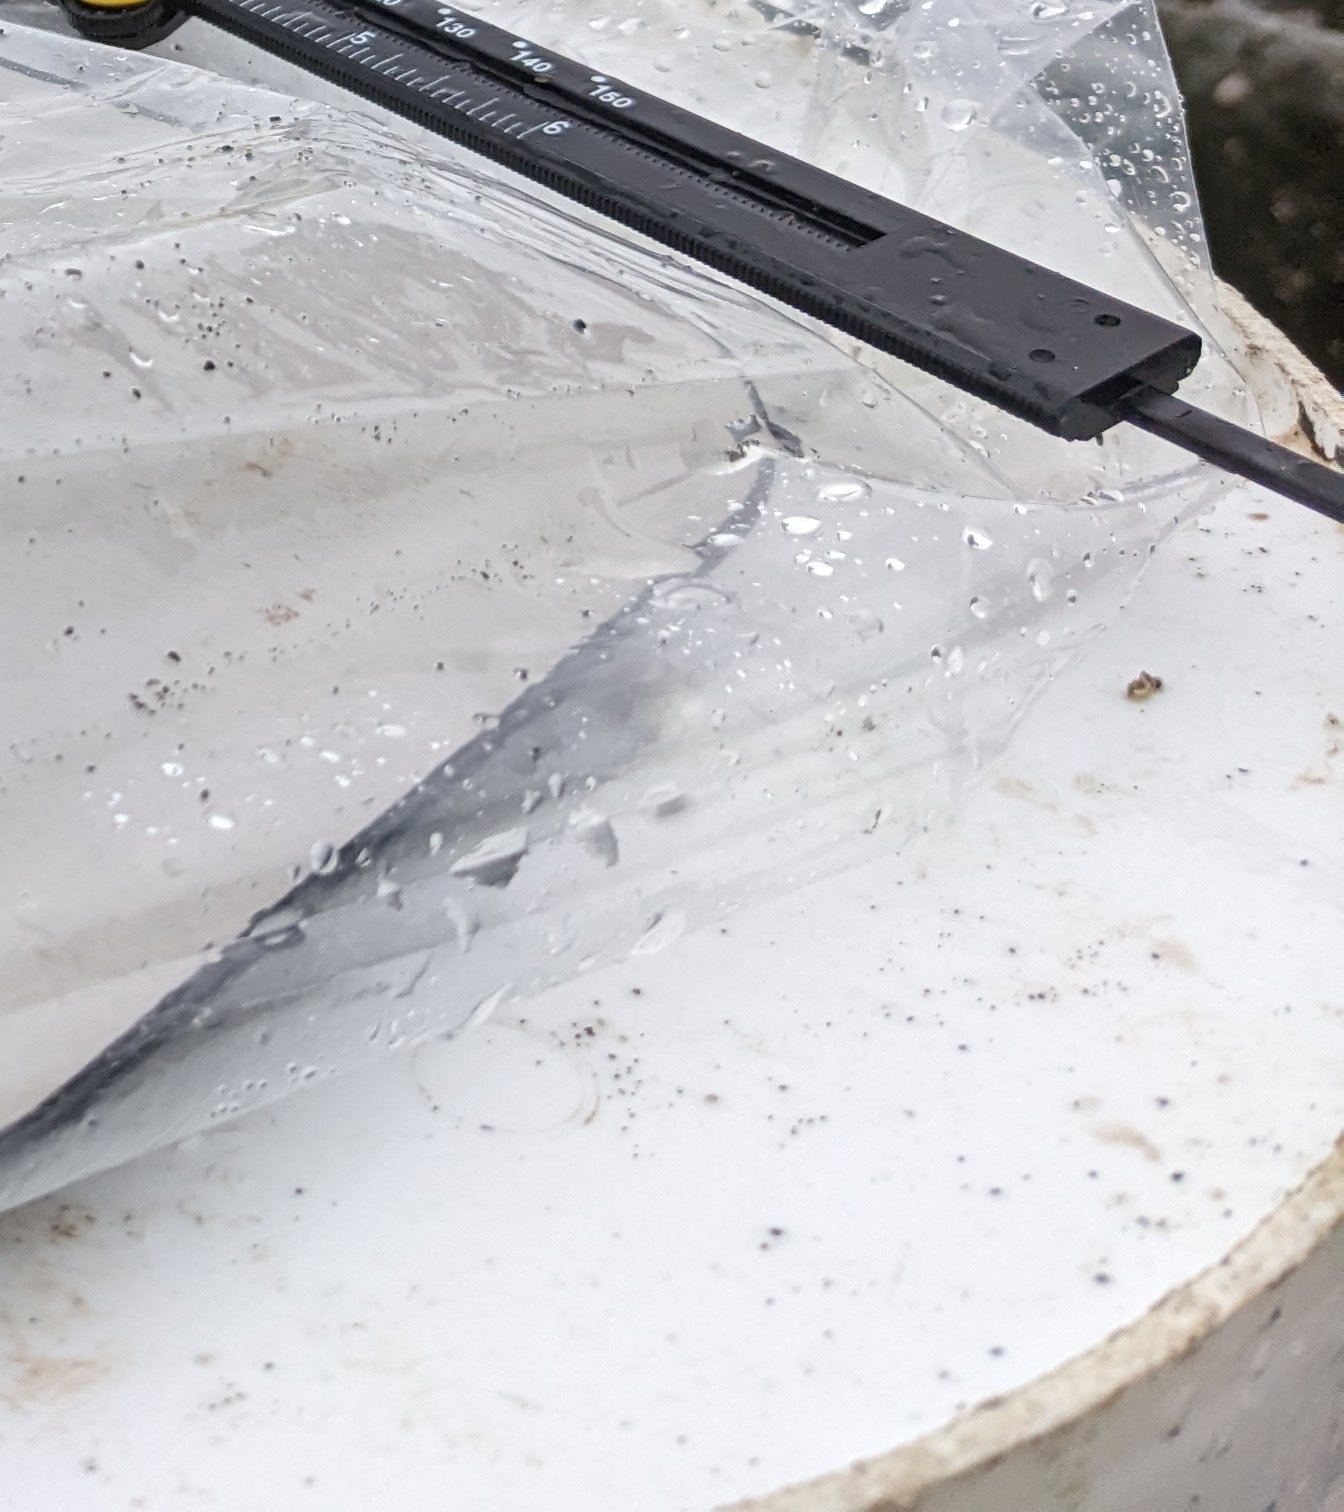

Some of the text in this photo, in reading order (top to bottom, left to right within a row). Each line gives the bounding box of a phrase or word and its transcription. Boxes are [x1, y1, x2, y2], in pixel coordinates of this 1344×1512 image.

[349, 30, 377, 45] 5
[542, 120, 571, 136] 6
[435, 16, 477, 39] 130
[510, 50, 555, 73] 140
